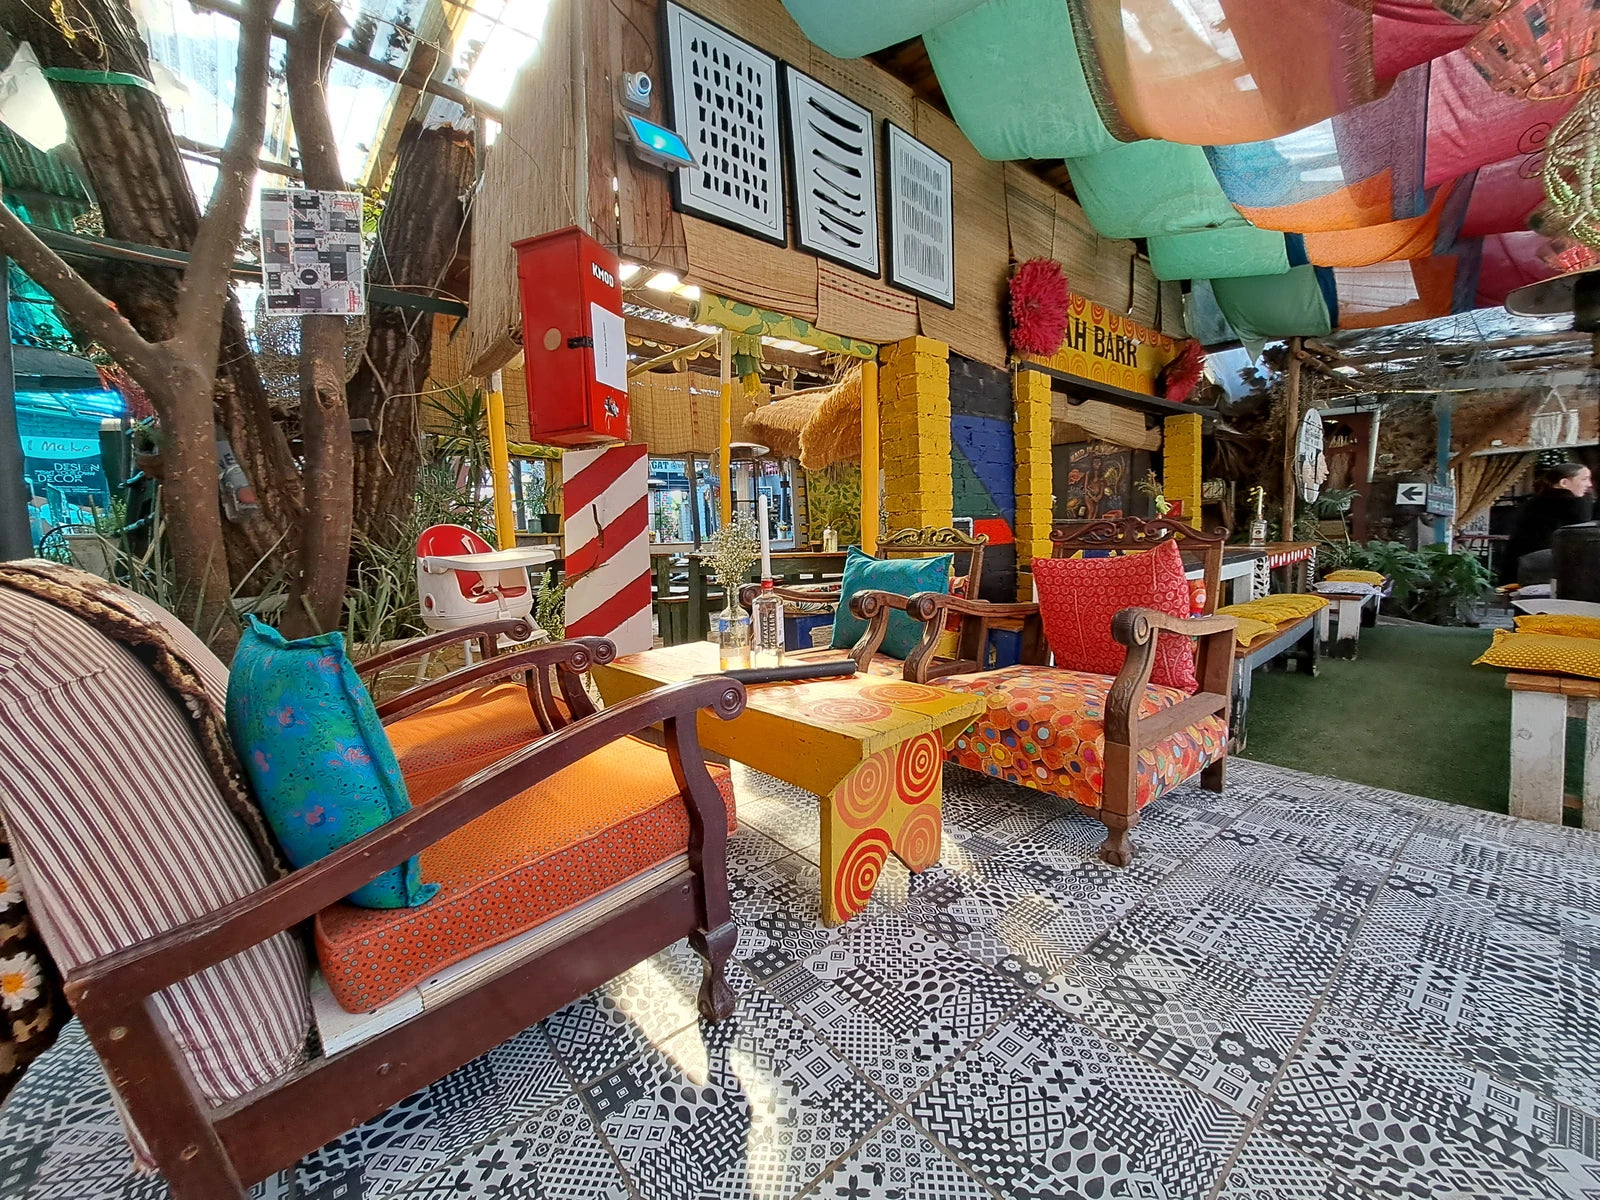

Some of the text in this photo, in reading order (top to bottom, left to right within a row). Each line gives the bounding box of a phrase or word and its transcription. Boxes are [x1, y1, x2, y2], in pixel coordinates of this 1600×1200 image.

[591, 262, 615, 289] KMOD
[1093, 325, 1138, 369] BARR
[54, 462, 100, 472] DESIGN
[37, 474, 83, 483] DECOR
